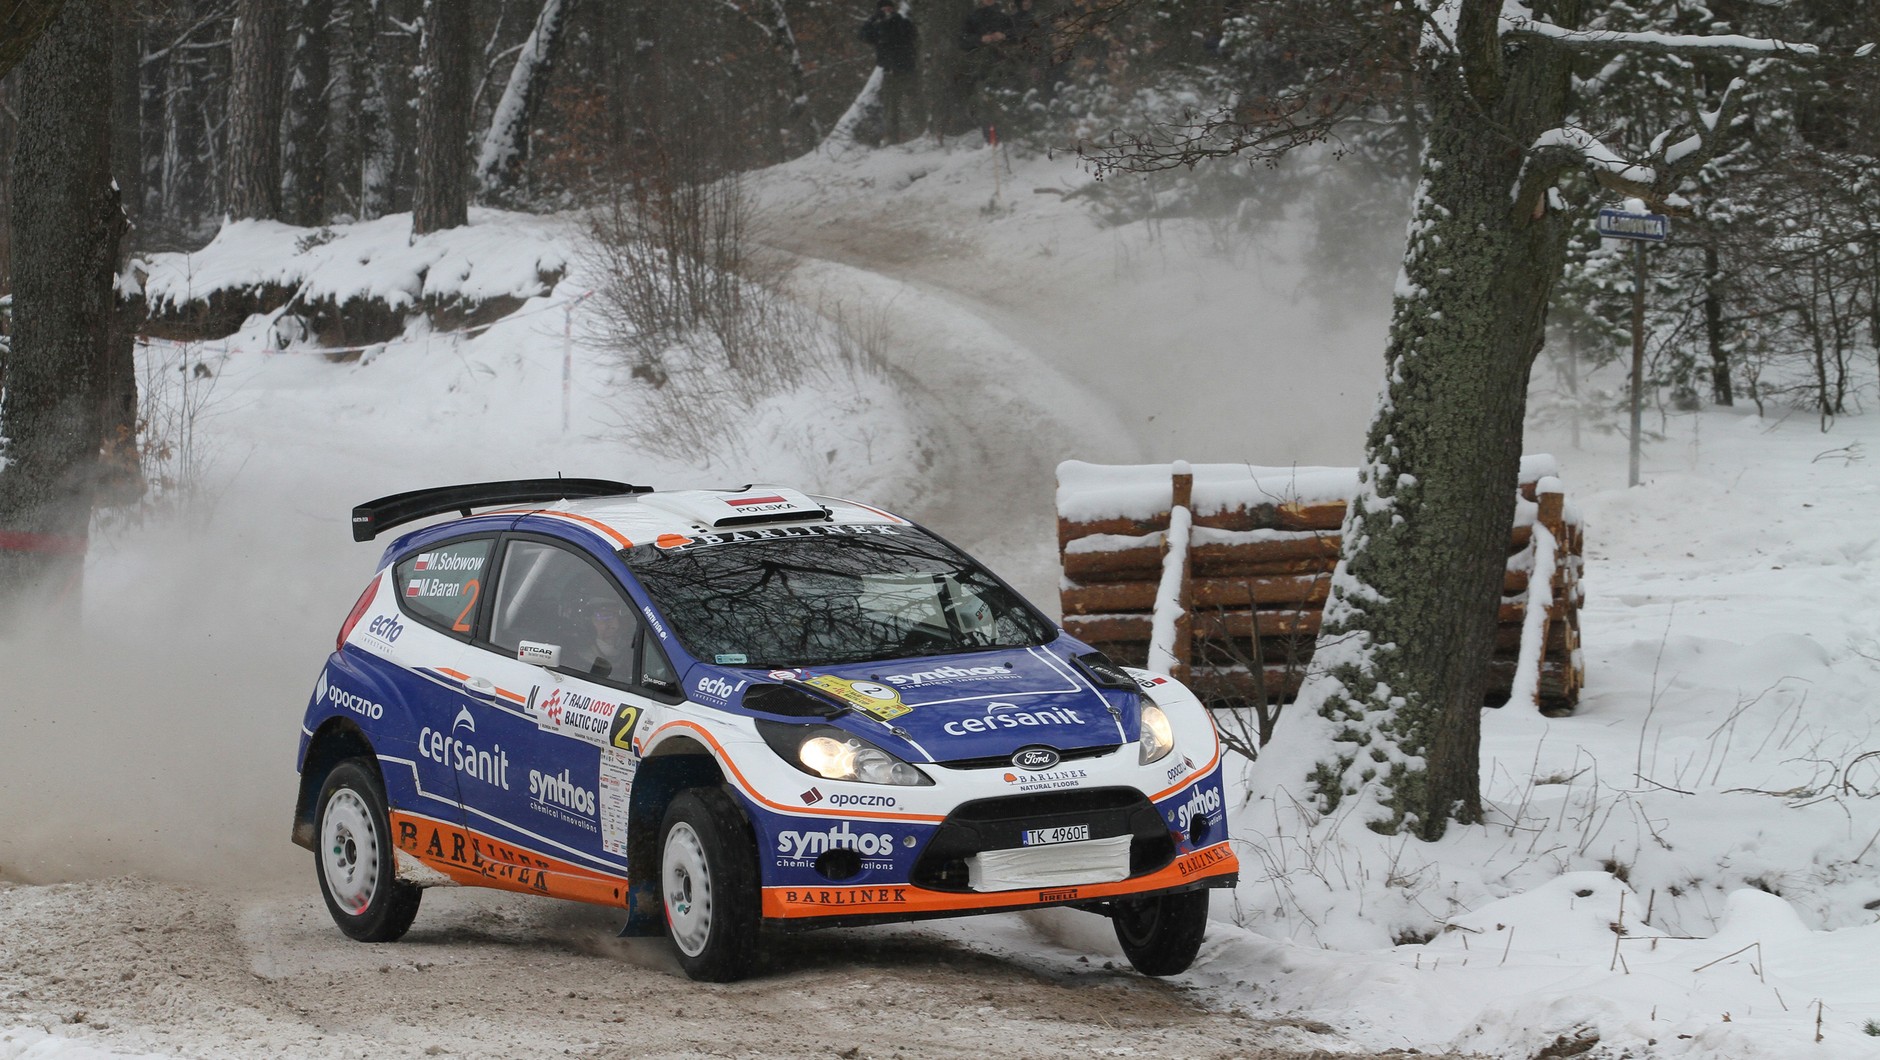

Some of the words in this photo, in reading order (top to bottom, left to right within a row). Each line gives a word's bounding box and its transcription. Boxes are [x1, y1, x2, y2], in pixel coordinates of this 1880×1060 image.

[736, 503, 797, 514] POLSKA
[705, 525, 901, 545] BARLINEK
[418, 578, 459, 597] M.Baran
[452, 578, 480, 632] 2
[369, 613, 404, 643] echo
[520, 646, 553, 656] GETCAR
[885, 666, 1012, 684] synthos
[698, 677, 733, 699] echo
[329, 685, 383, 720] opoczno
[563, 691, 570, 705] 7
[569, 694, 590, 711] RAJD
[588, 700, 615, 717] LOTOS
[692, 693, 728, 707] INVESTMENT
[564, 711, 591, 731] BALTIC
[591, 717, 609, 735] CUP
[614, 706, 637, 750] 2
[944, 706, 1085, 736] cersanit
[418, 726, 509, 791] cersanit
[1023, 751, 1051, 765] Ford
[1020, 769, 1088, 783] BARLINEK
[1020, 782, 1051, 792] NATURAL
[1052, 780, 1080, 788] FLOORS
[529, 768, 596, 816] synthos
[829, 794, 896, 808] opoczno
[530, 802, 559, 818] chemical
[560, 812, 597, 834] innovations
[1178, 784, 1221, 832] synthos
[777, 821, 894, 860] synthos
[1029, 830, 1046, 845] TK
[1052, 825, 1088, 842] 4960F
[398, 821, 549, 892] BARLINEK
[776, 858, 815, 869] chemic
[1178, 846, 1231, 875] BARLINEK
[786, 888, 907, 904] BARLINEK
[1039, 888, 1078, 902] PIRELLI
